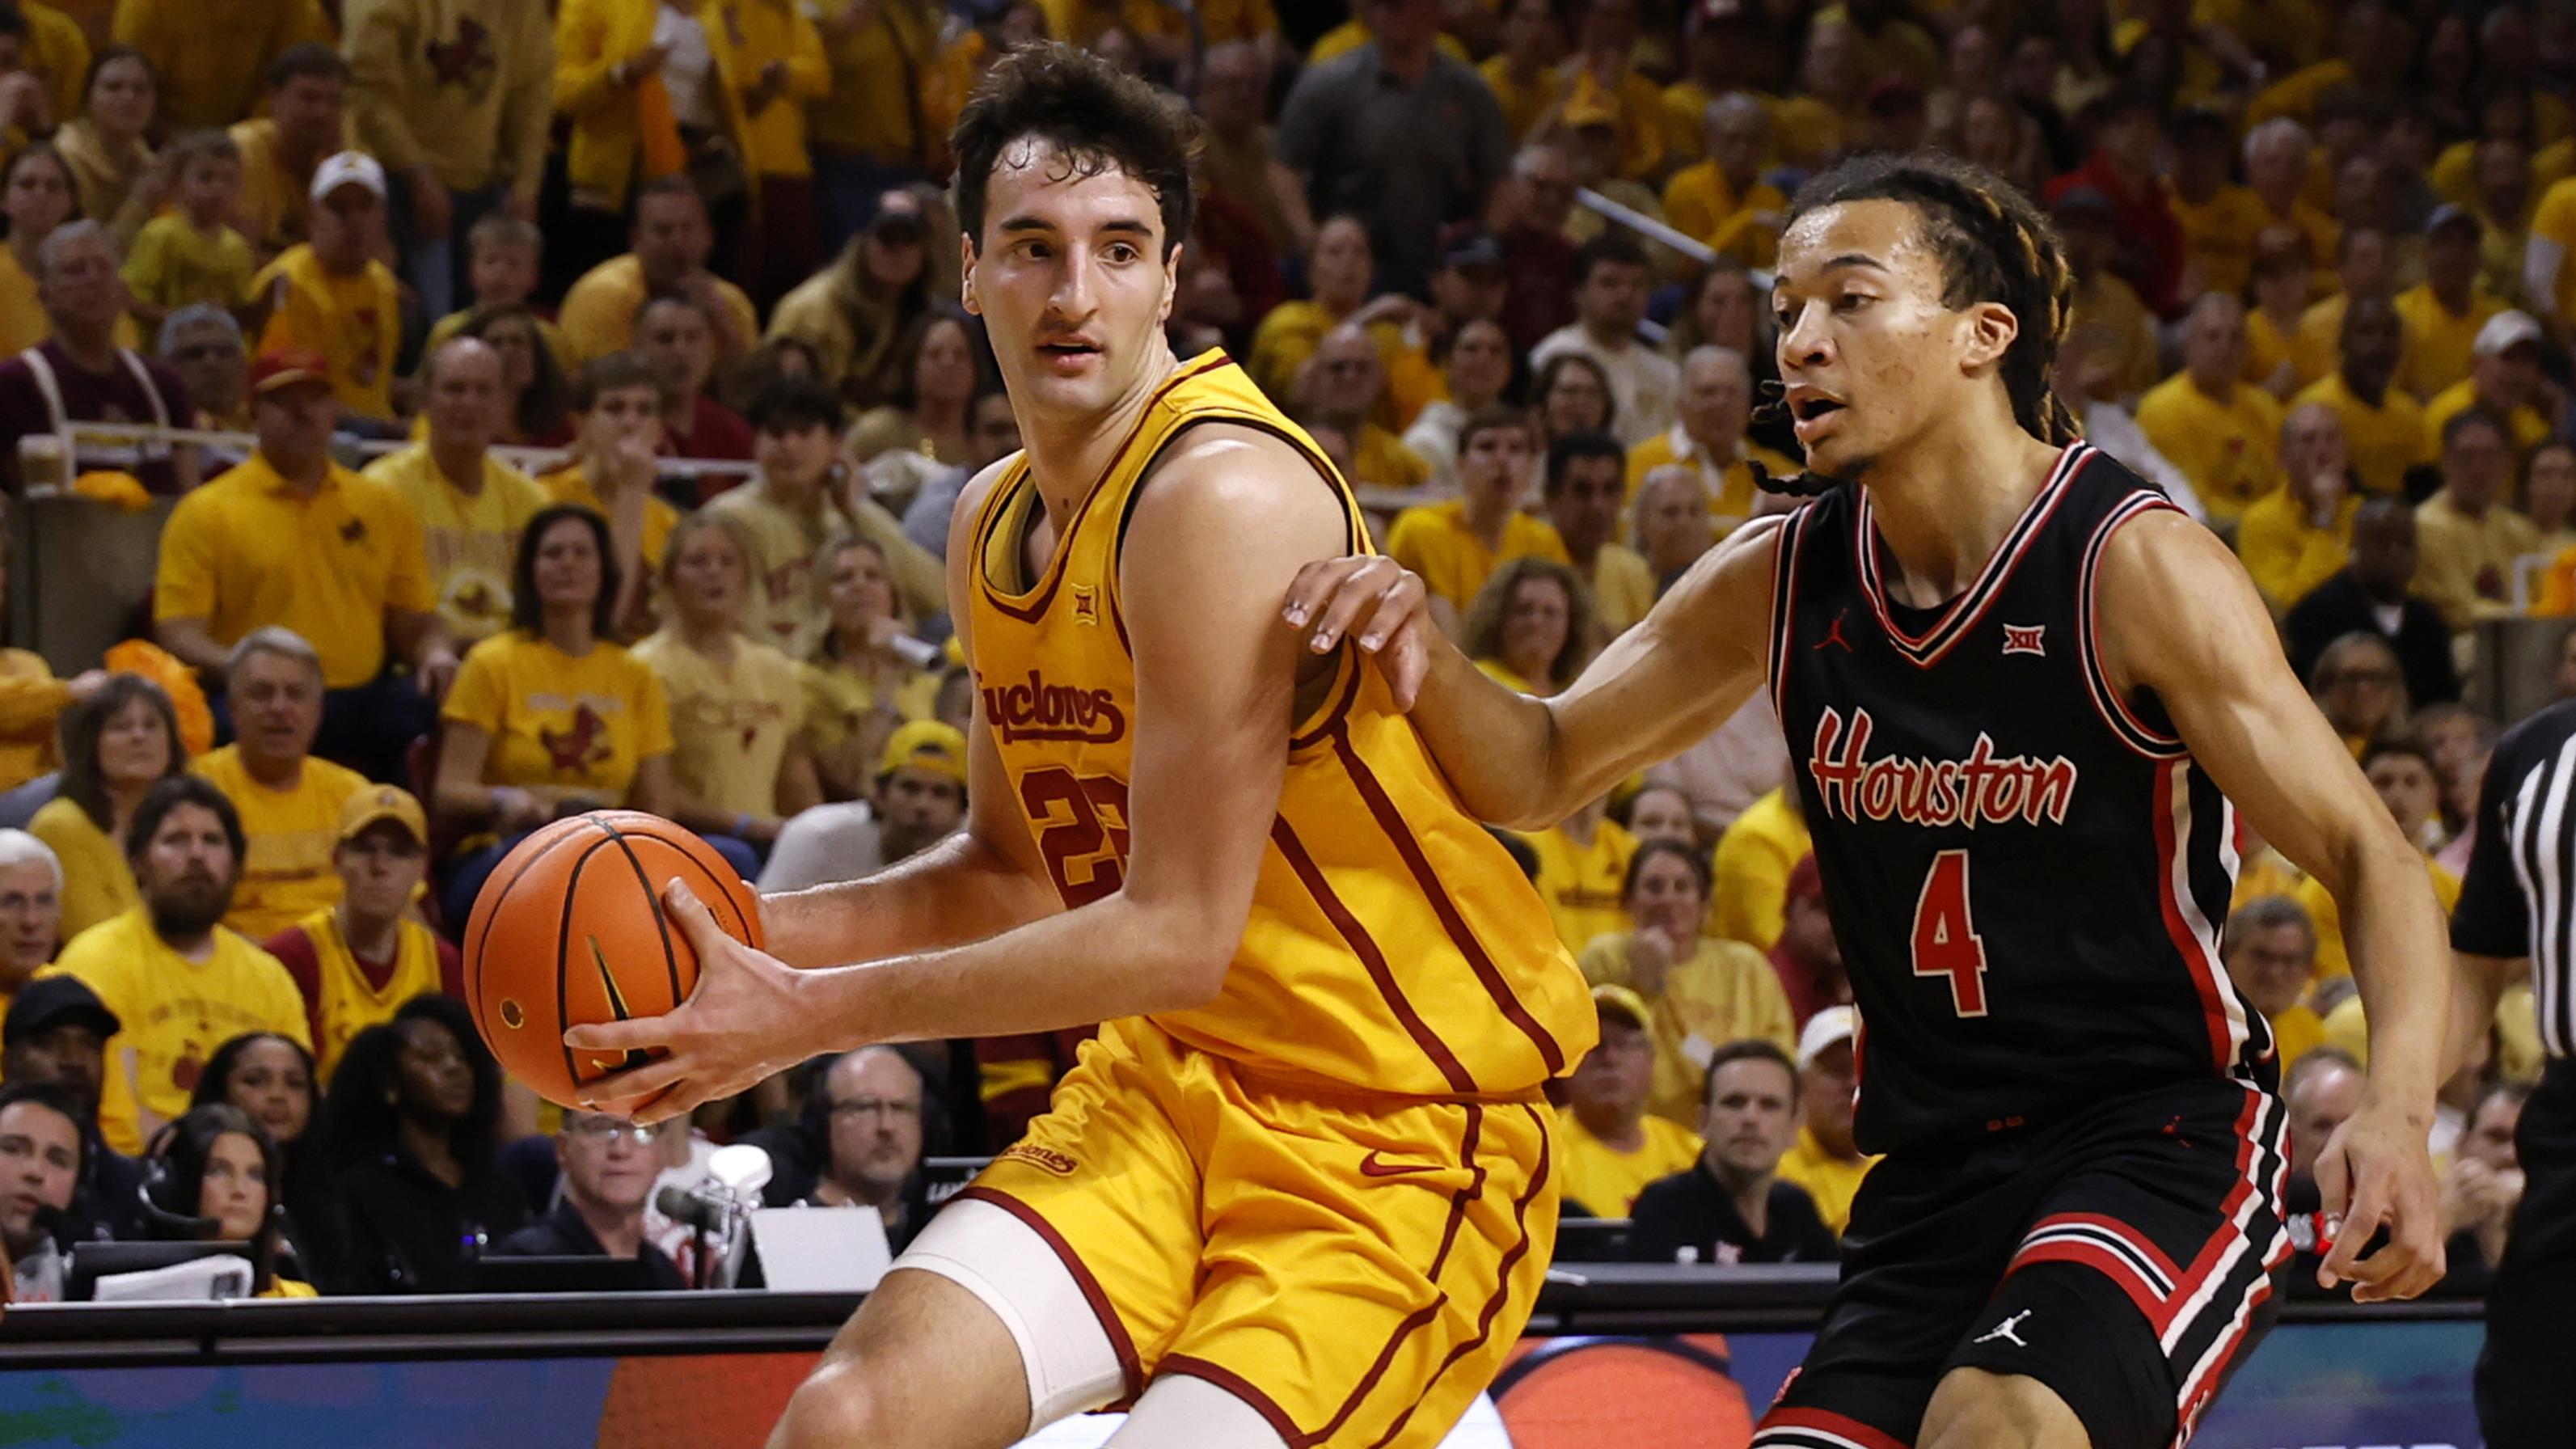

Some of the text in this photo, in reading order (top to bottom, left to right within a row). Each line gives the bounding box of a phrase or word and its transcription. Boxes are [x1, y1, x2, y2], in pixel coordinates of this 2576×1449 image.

[2004, 625, 2044, 654] XII
[975, 669, 1125, 745] yclones
[1809, 705, 2077, 830] Houston
[1911, 848, 1988, 1018] 4
